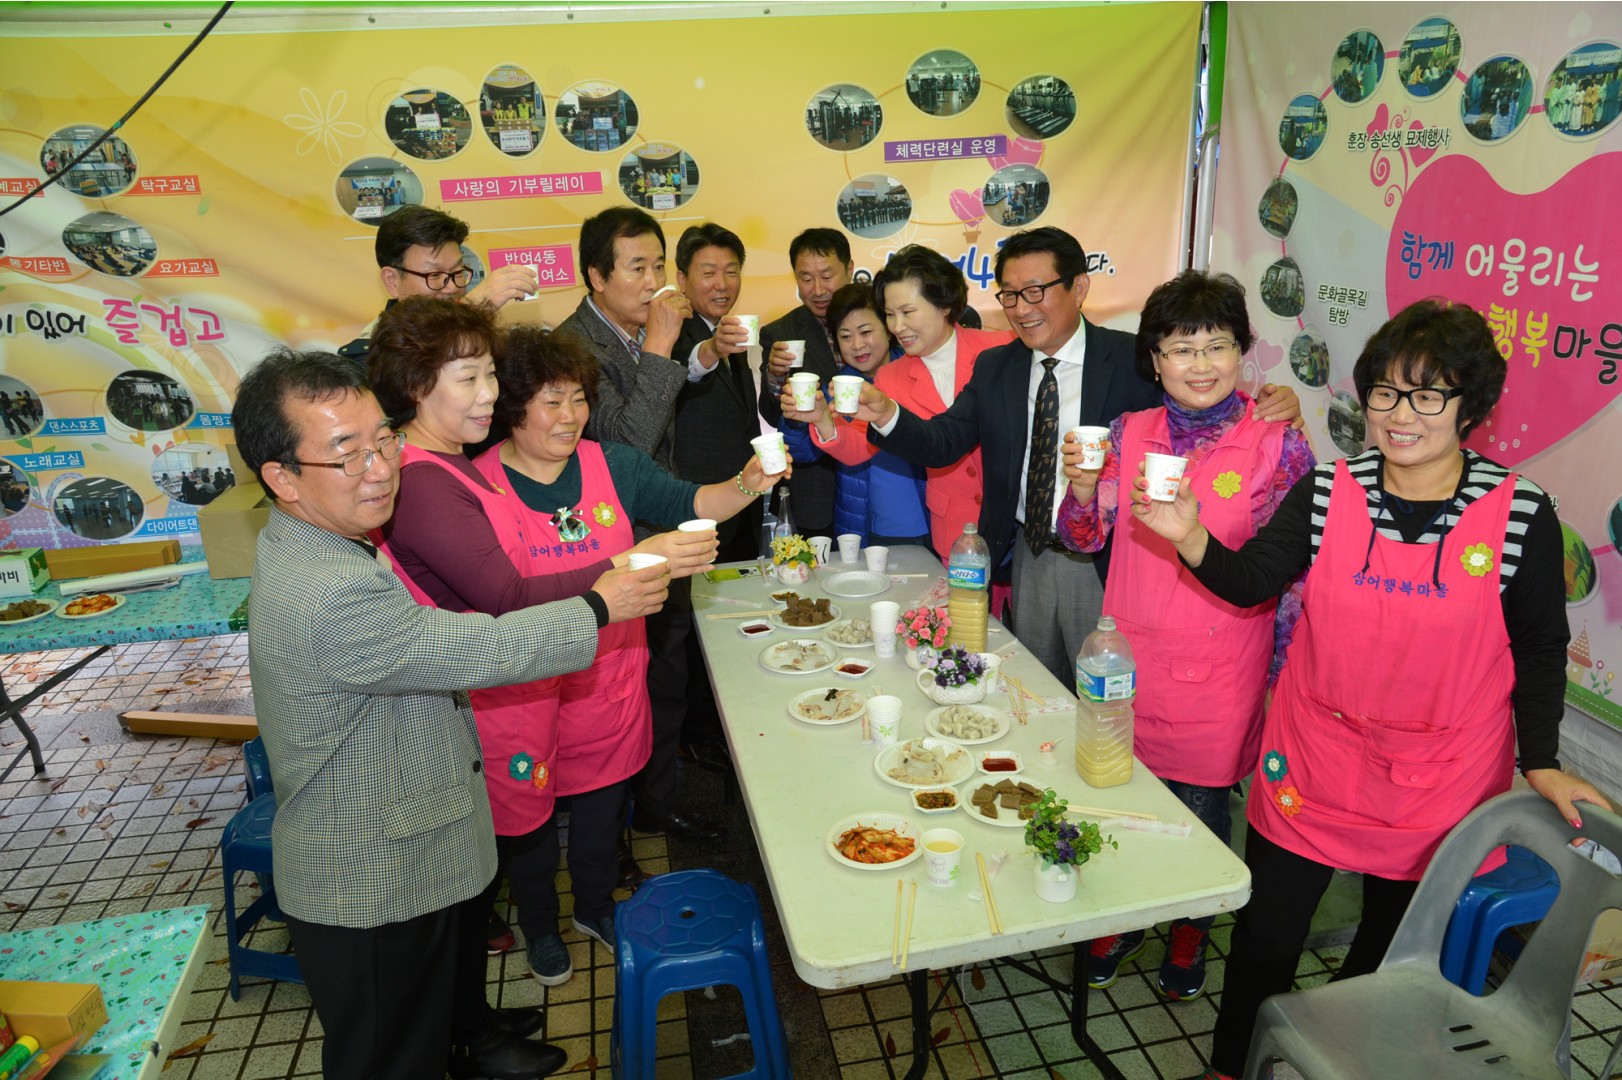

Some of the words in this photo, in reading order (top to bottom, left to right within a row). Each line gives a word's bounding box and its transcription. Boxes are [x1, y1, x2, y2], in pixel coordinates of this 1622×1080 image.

[1347, 131, 1368, 149] 훈장
[1370, 131, 1402, 149] 송선생
[1405, 127, 1450, 147] 묘제행사
[895, 140, 963, 159] 체력단련실
[970, 138, 997, 155] 운영
[141, 177, 196, 193] 탁구교실
[453, 179, 501, 197] 사랑의
[508, 174, 585, 194] 기부릴레이
[159, 260, 214, 275] 요가교실
[504, 249, 557, 266] 반여4동
[1400, 231, 1455, 280] 함께
[1465, 238, 1600, 302] 어울리는
[1317, 284, 1368, 307] 문화골목길
[26, 309, 86, 339] 있어
[103, 299, 225, 347] 즐겁고
[1328, 306, 1350, 325] 탐방
[49, 420, 100, 433] 댄스스포츠
[24, 453, 80, 469] 노래교실
